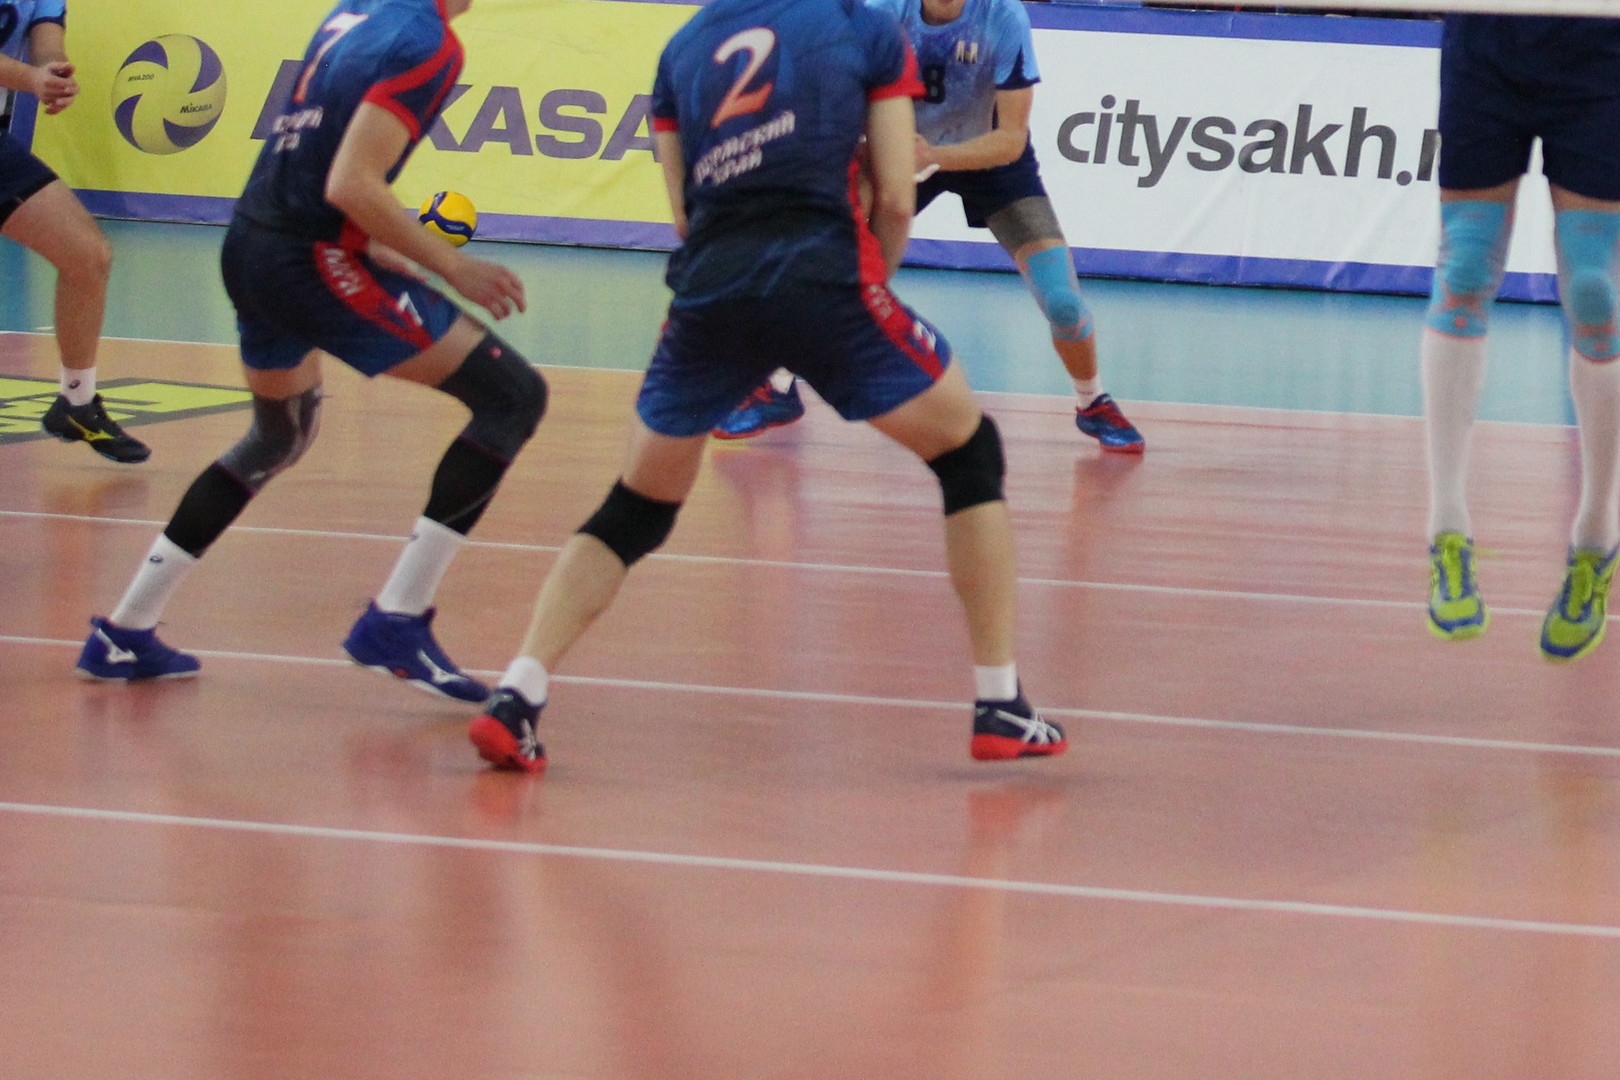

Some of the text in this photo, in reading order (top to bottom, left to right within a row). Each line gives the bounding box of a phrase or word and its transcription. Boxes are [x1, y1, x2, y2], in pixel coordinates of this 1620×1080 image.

[293, 10, 369, 103] 7
[711, 27, 776, 129] 2
[250, 59, 662, 163] KASA
[1057, 94, 1441, 188] citysakh.r
